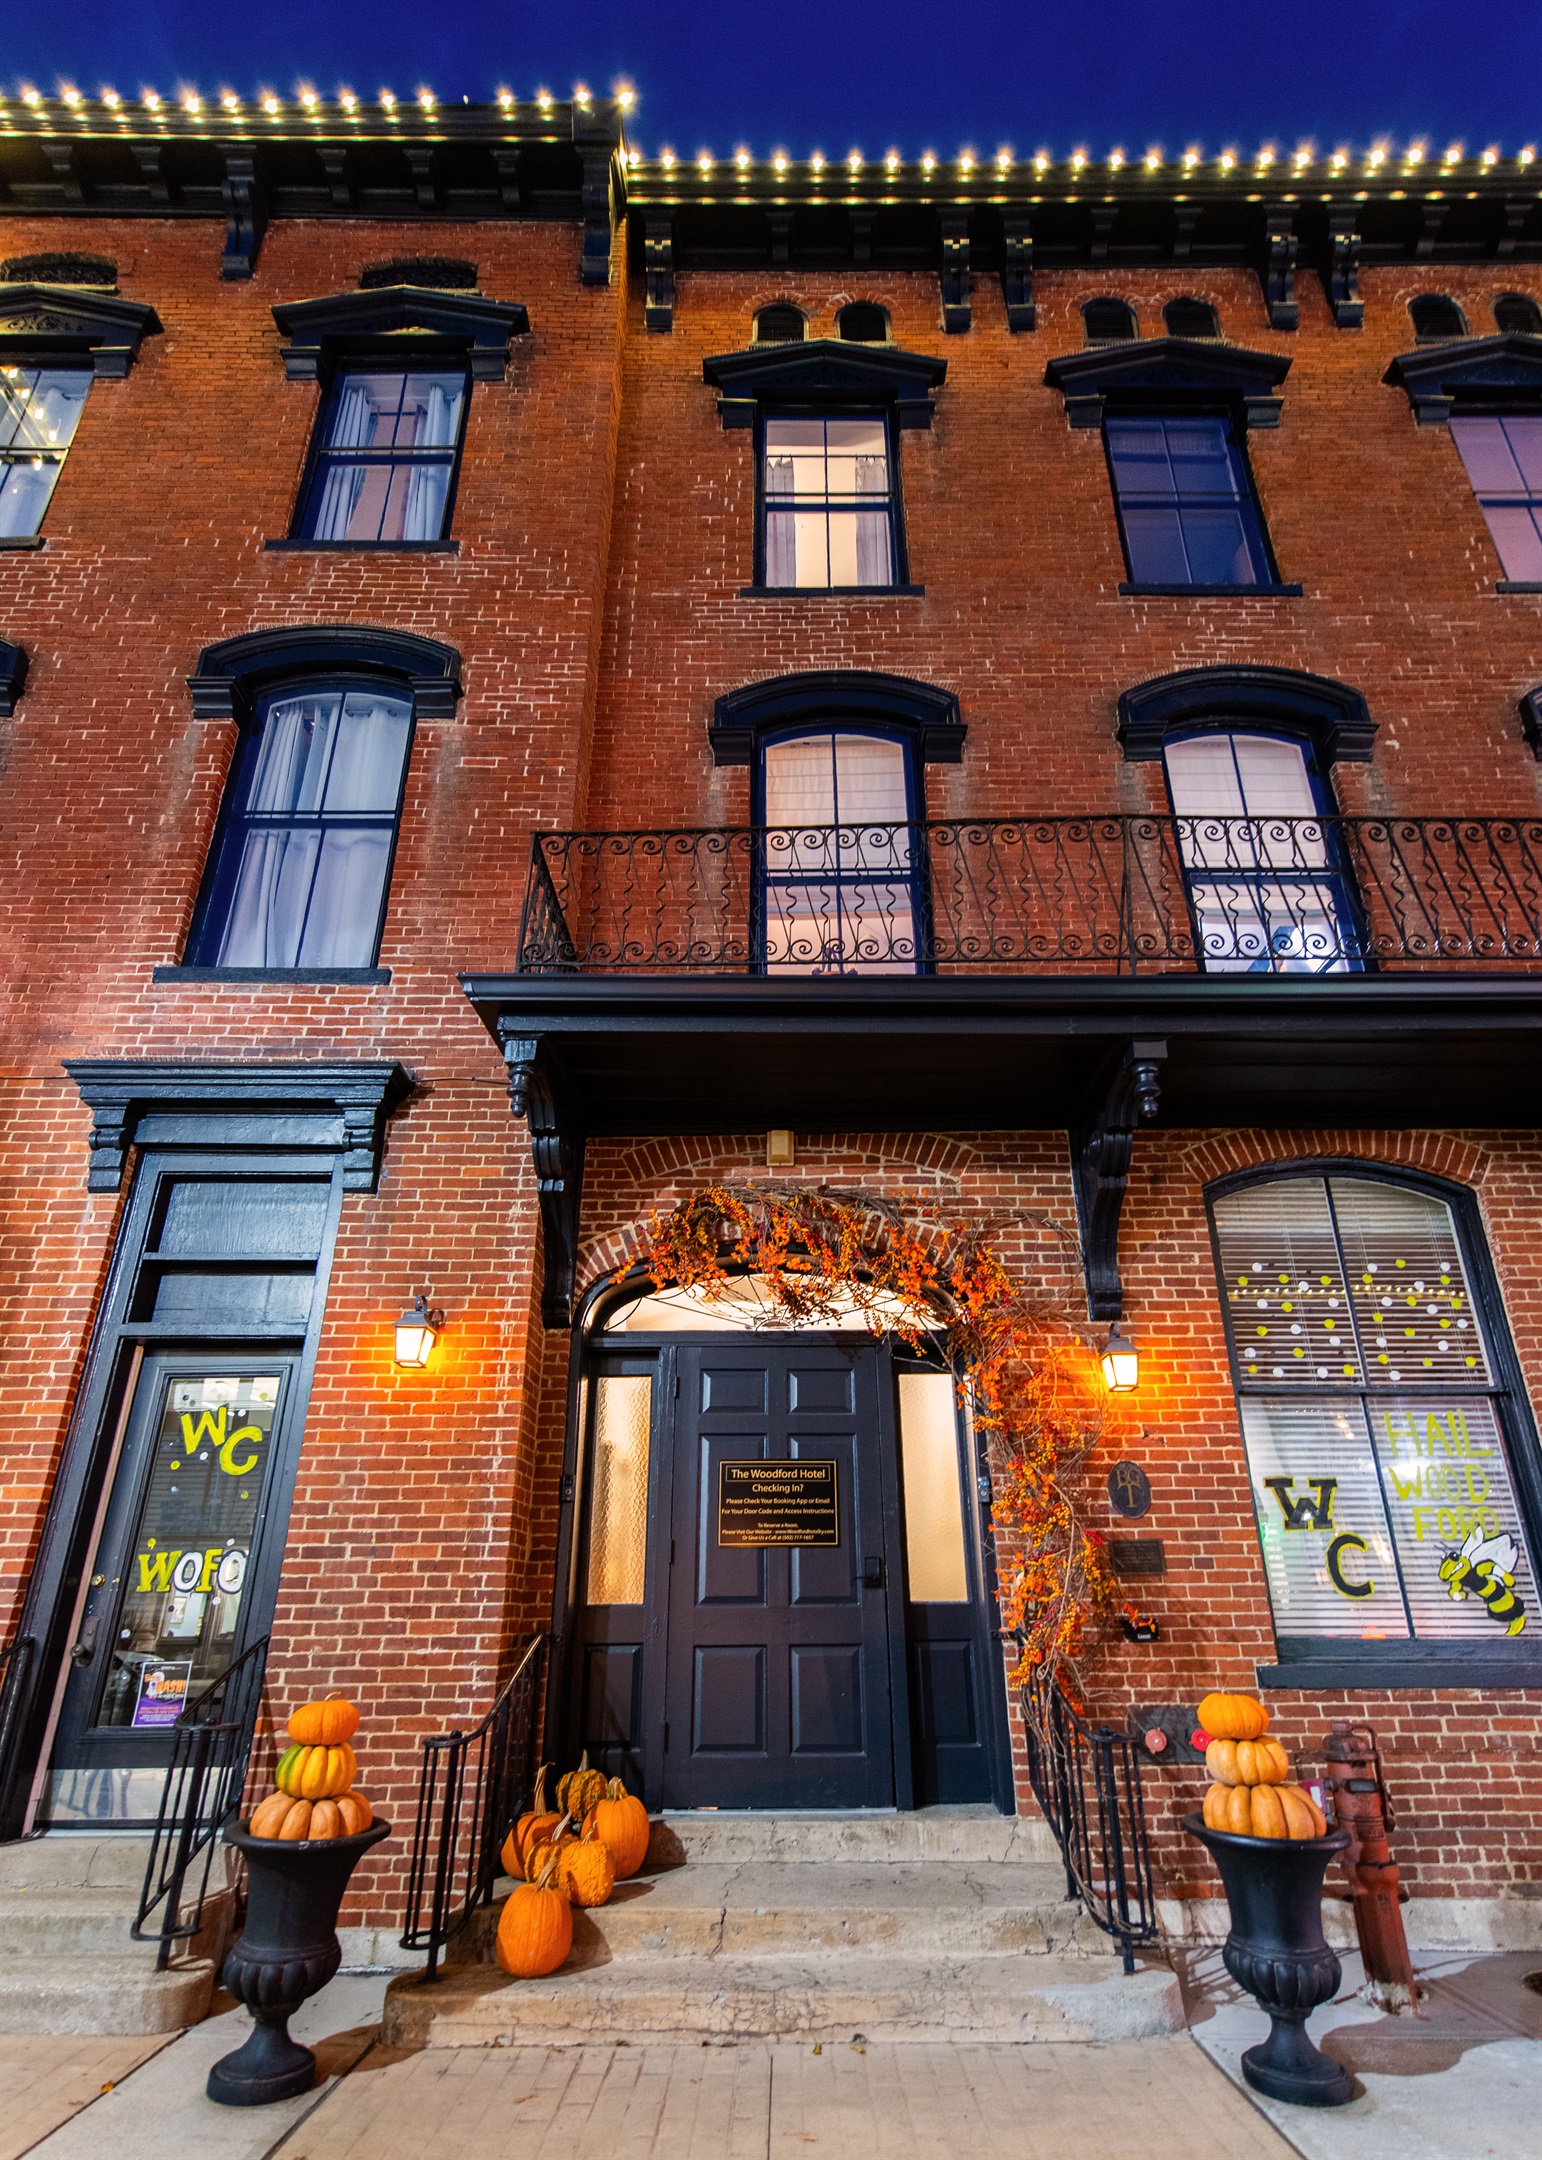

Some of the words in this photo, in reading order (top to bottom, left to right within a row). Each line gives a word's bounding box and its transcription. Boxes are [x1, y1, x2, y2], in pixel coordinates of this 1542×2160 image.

[1383, 1408, 1494, 1457] HAIL
[731, 1469, 749, 1478] The
[751, 1469, 798, 1478] Woodford
[800, 1469, 825, 1478] Hotel
[752, 1484, 790, 1494] Checking
[792, 1484, 804, 1492] In?
[1389, 1464, 1491, 1503] WOOD
[1412, 1506, 1500, 1541] FORD
[136, 1548, 246, 1594] WOFO
